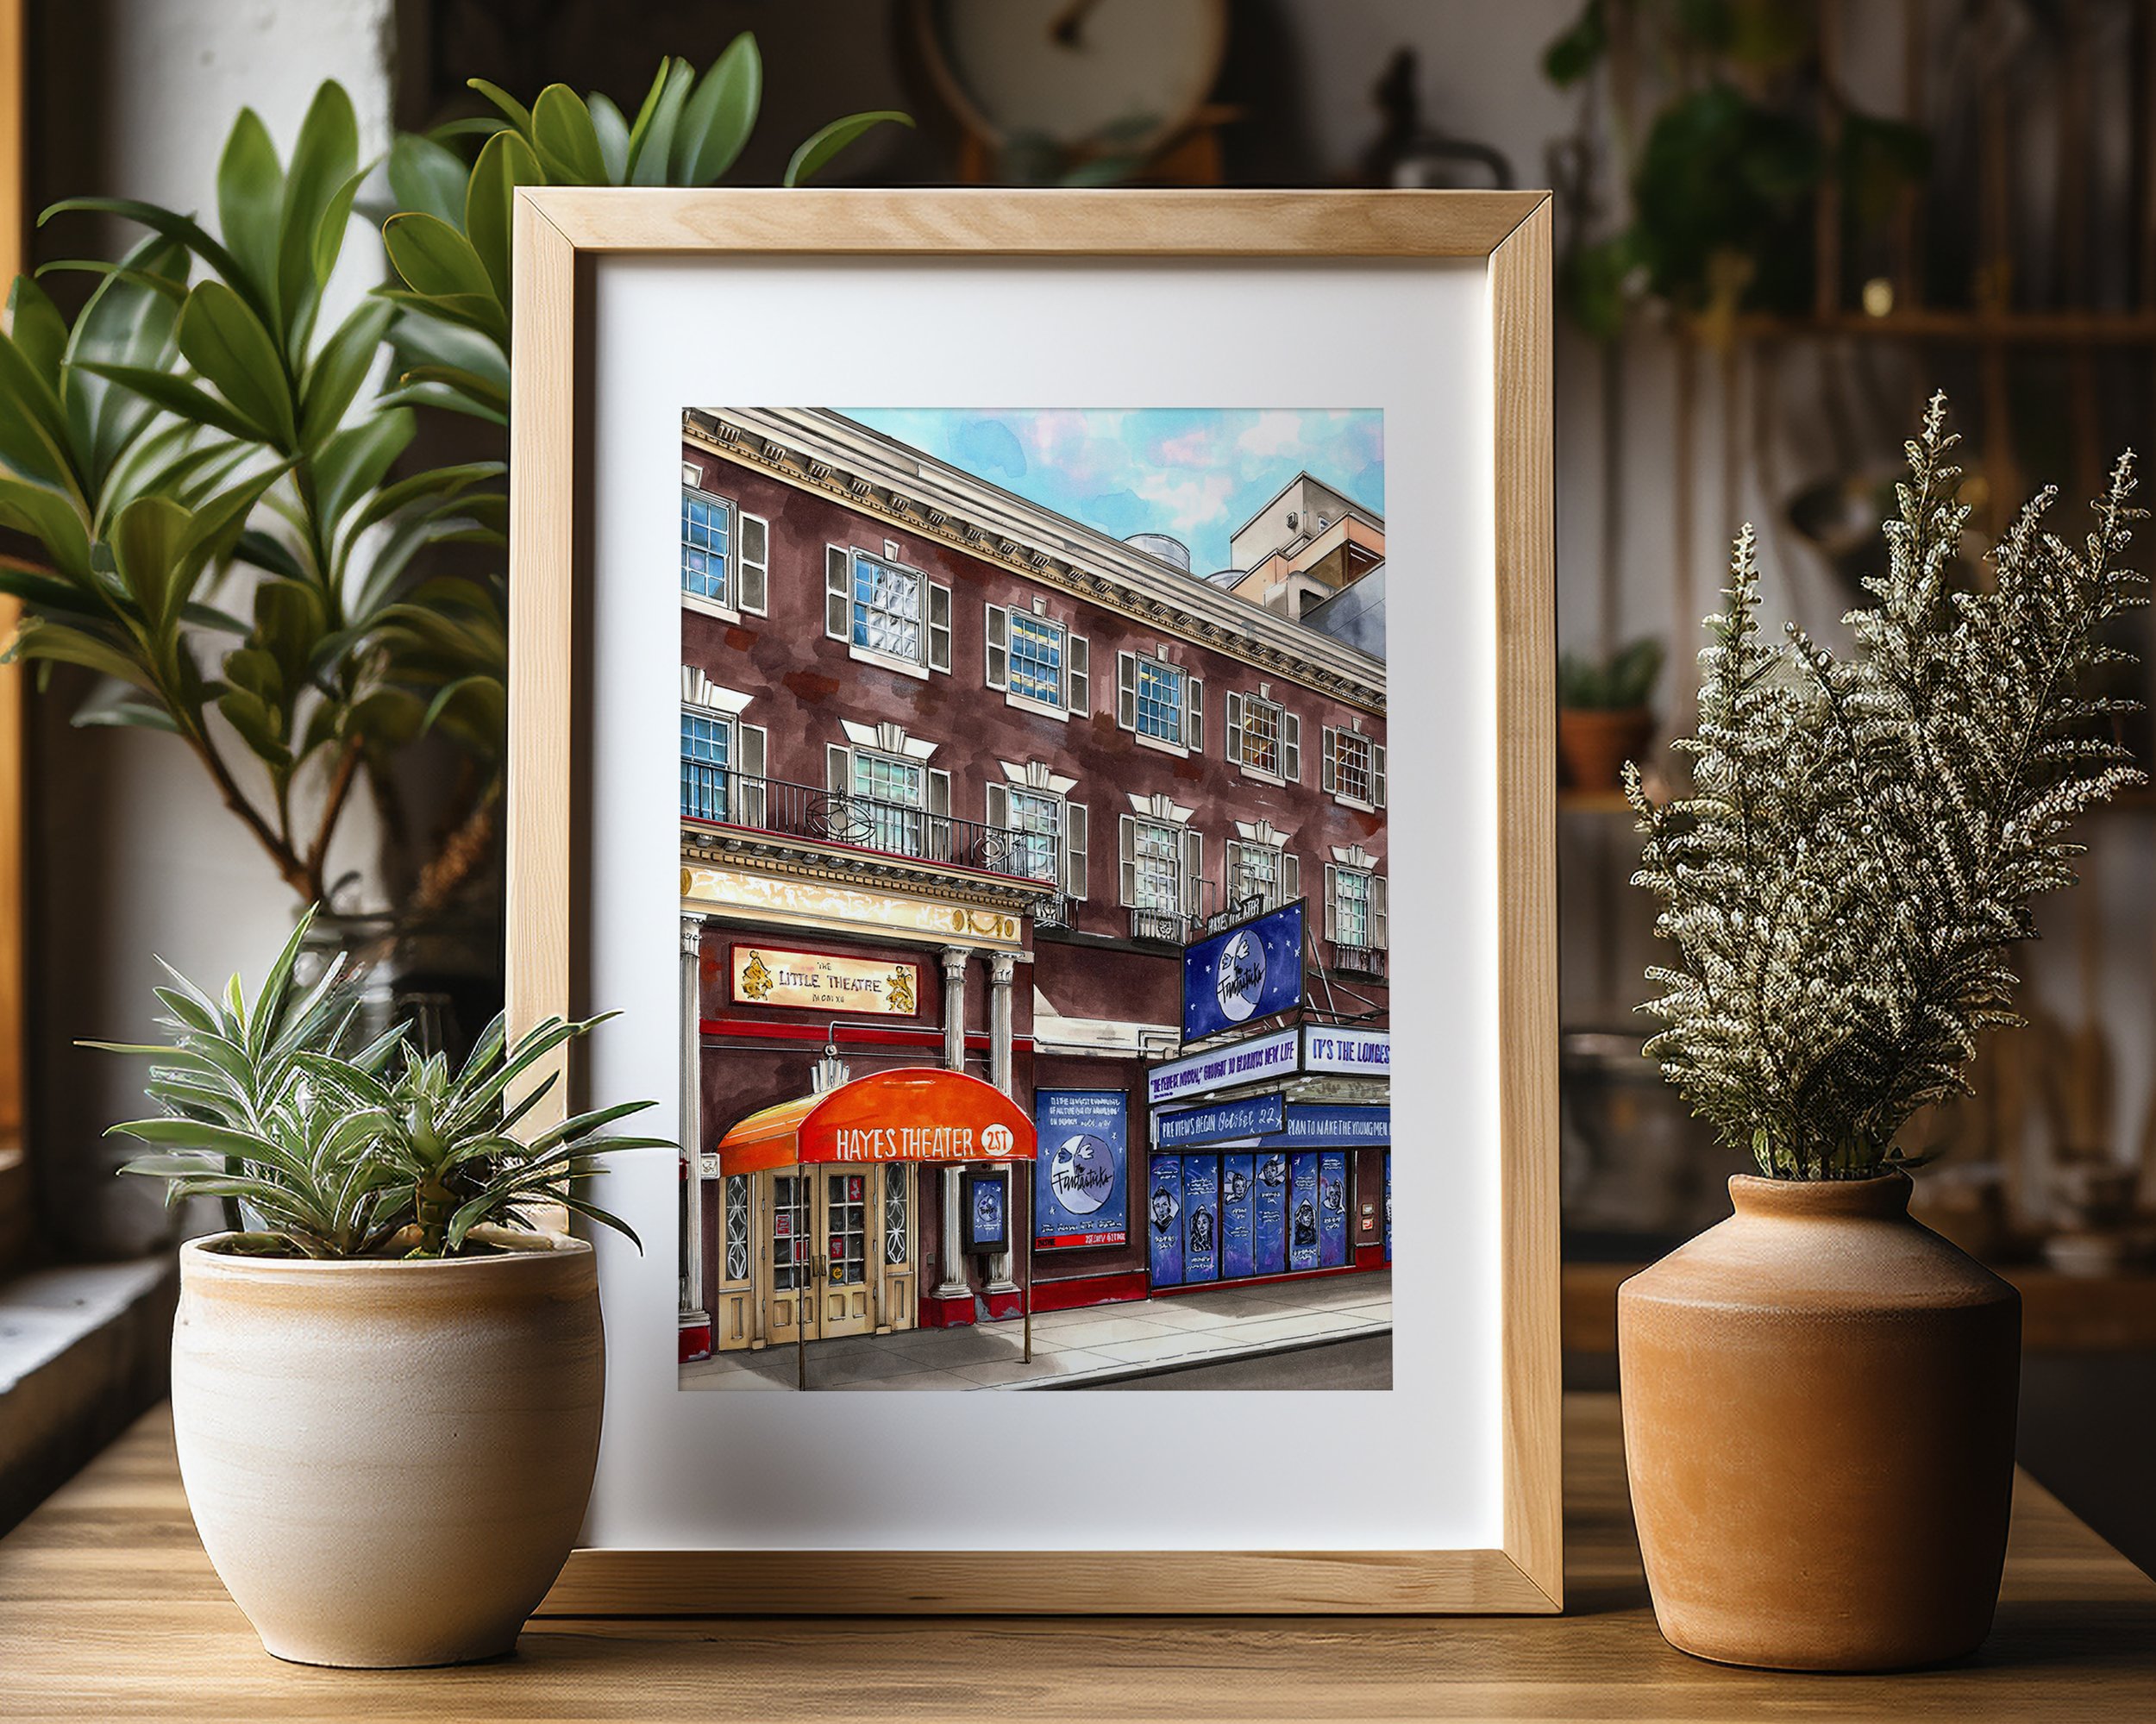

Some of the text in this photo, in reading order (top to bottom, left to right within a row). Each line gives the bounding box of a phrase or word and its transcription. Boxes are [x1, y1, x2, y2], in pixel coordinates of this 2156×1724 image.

[779, 970, 882, 993] LITTLE THEATRE
[1280, 1041, 1294, 1062] LIFE
[1313, 1038, 1334, 1060] IT'S
[1336, 1040, 1355, 1063] THE
[1288, 1119, 1307, 1136] PLAN
[1307, 1119, 1316, 1136] TO
[1338, 1119, 1351, 1136] THE
[1373, 1121, 1388, 1137] MEN
[837, 1127, 975, 1160] HAYES THEATER
[987, 1131, 1008, 1150] 2ST
[1051, 1167, 1112, 1194] Fantasticks
